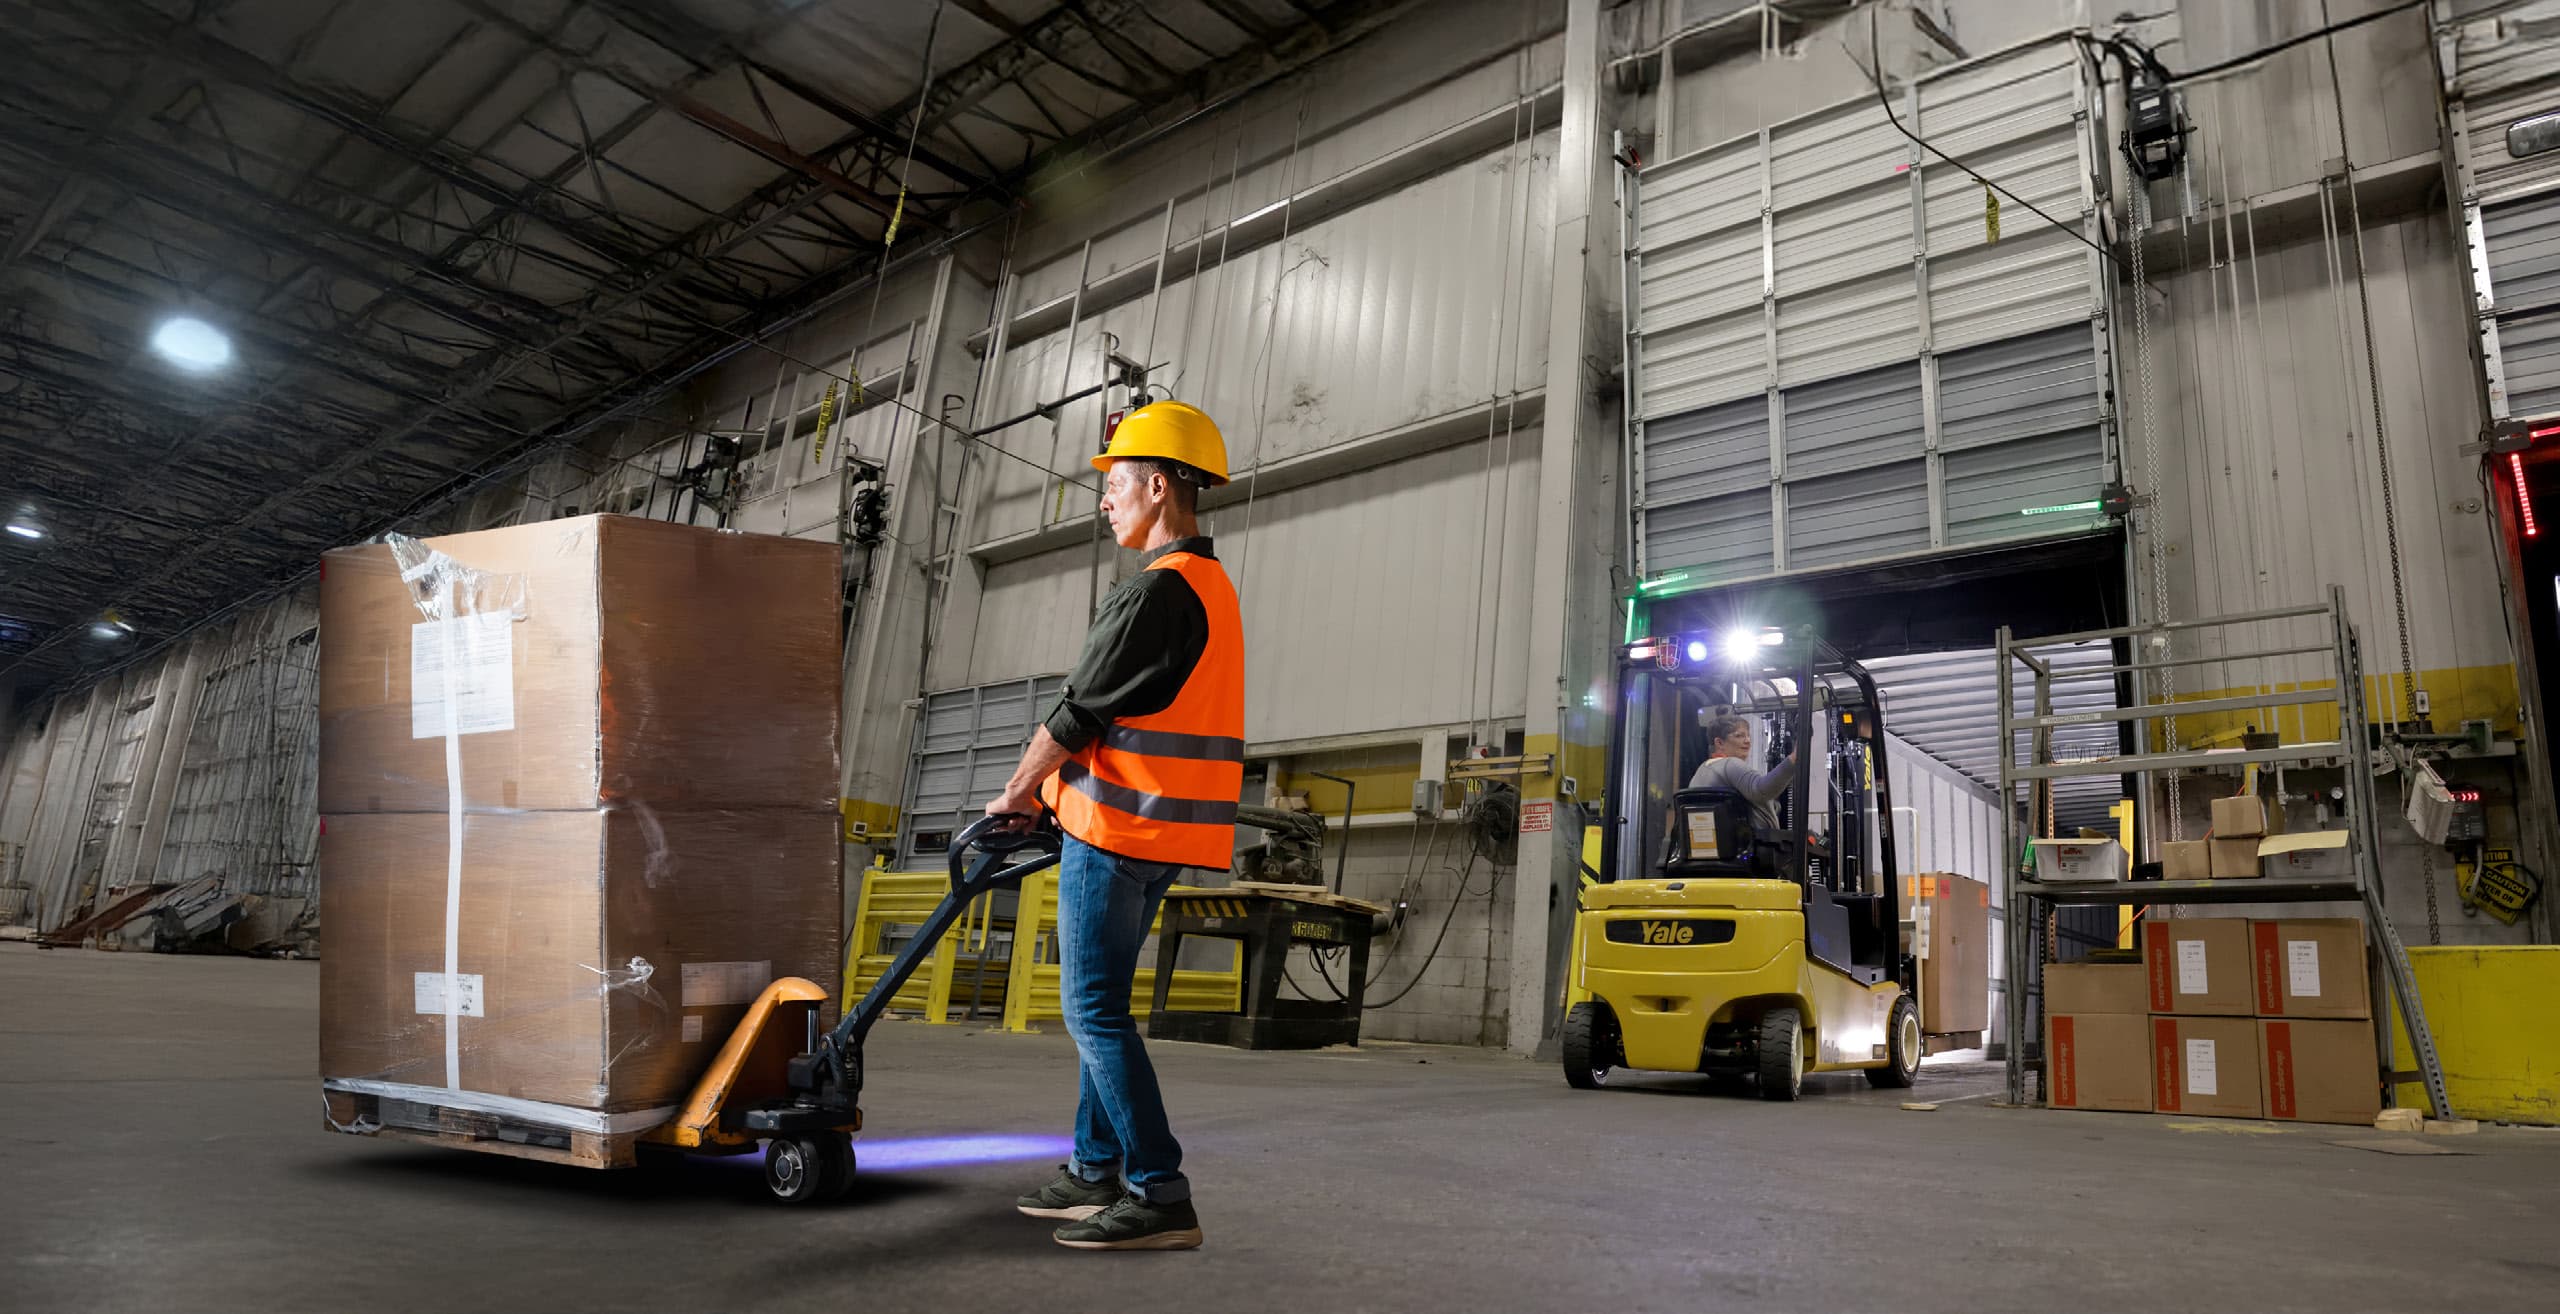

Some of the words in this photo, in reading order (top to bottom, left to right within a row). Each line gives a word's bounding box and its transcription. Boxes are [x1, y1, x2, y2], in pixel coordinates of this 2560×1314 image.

[1863, 744, 1872, 791] Yale
[2485, 870, 2526, 895] CAUTION
[1641, 920, 1694, 944] Yale
[1820, 1039, 1841, 1064] Yale
[2060, 1042, 2069, 1100] cordstrap
[2162, 1045, 2173, 1105] cordstrap
[2275, 1049, 2288, 1112] cordstrap
